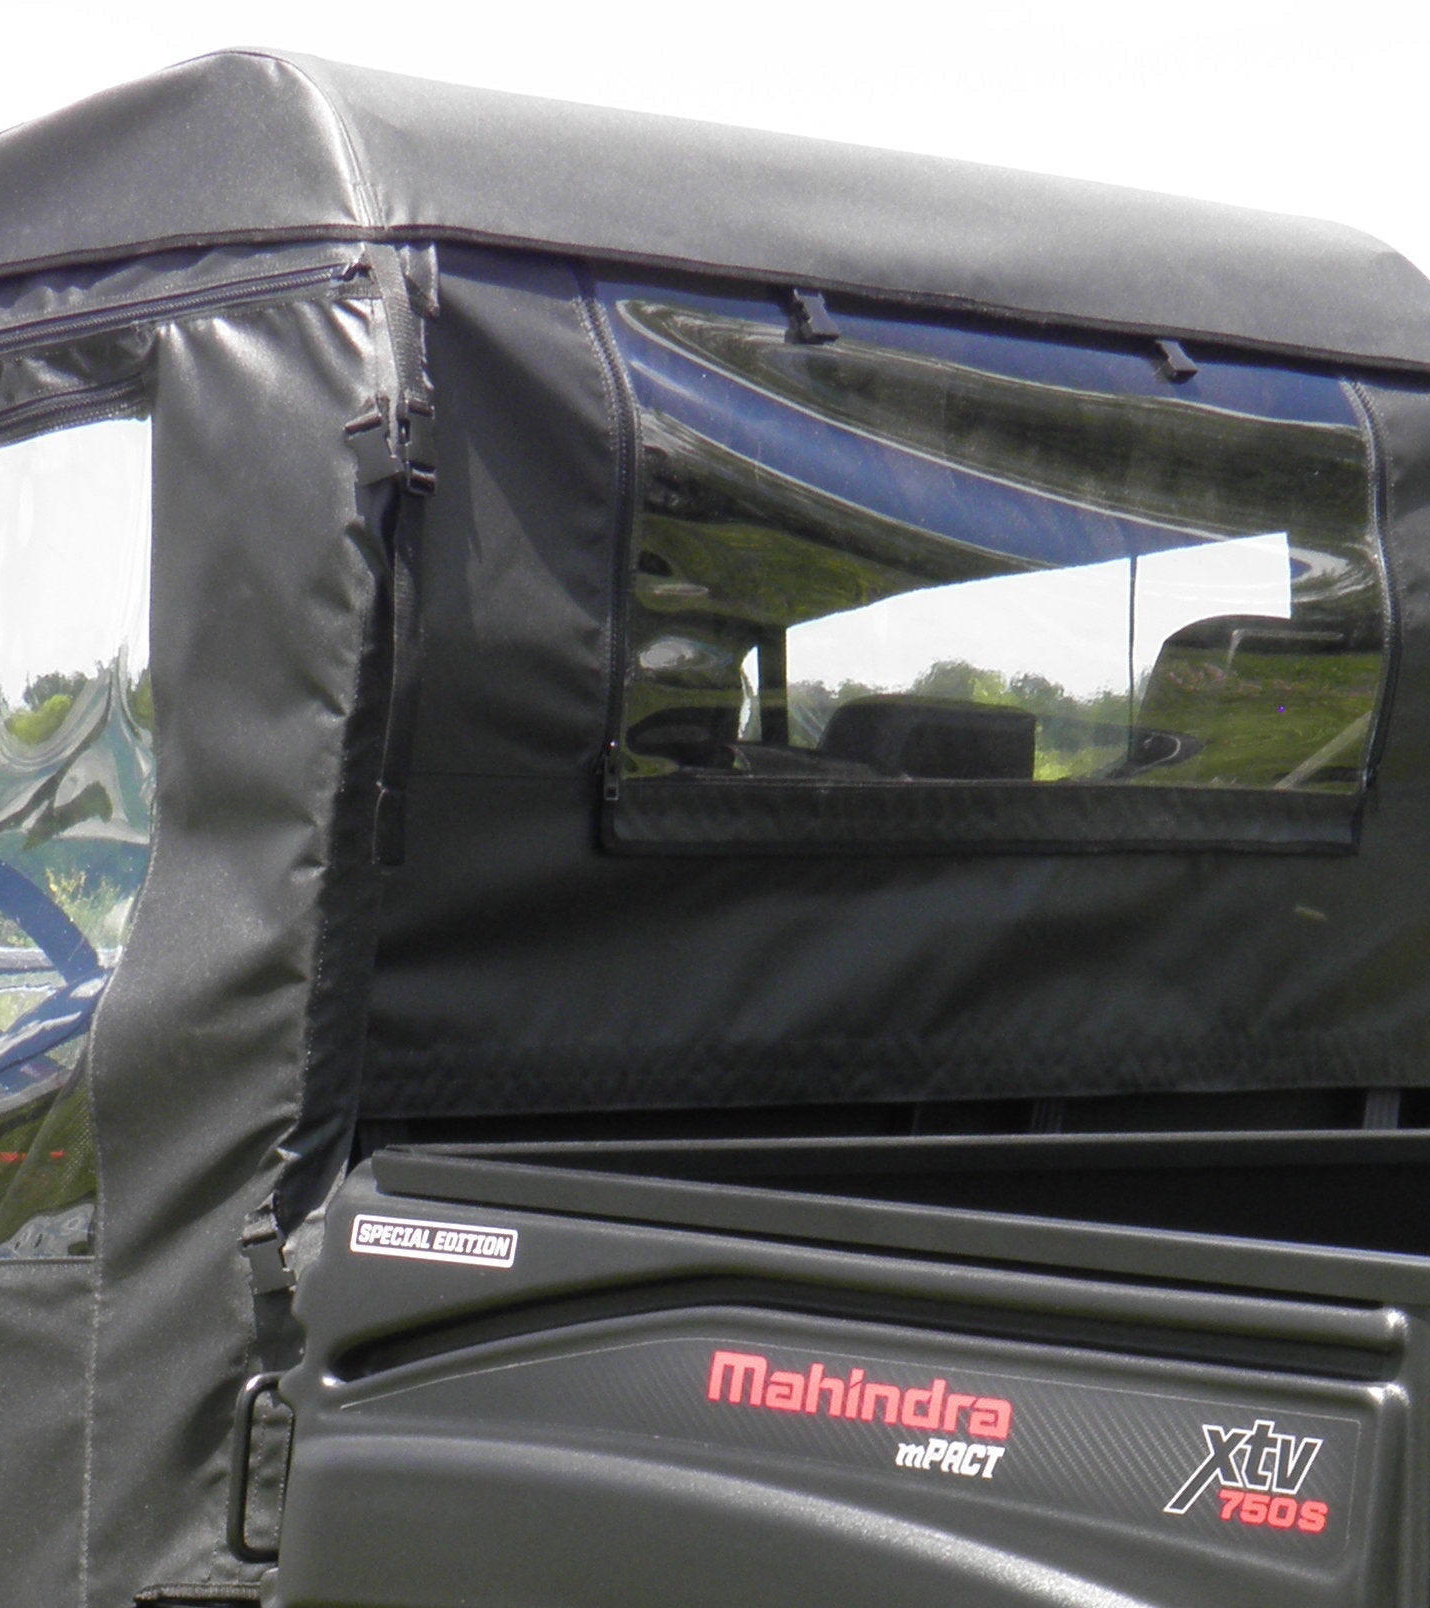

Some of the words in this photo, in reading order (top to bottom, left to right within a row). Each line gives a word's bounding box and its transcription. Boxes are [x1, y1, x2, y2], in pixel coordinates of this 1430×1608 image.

[358, 1223, 430, 1249] SPECIAL
[432, 1230, 510, 1257] EDITION
[707, 1350, 1013, 1440] Mahindra
[895, 1437, 1006, 1479] mPACT
[1217, 1488, 1329, 1534] 750S
